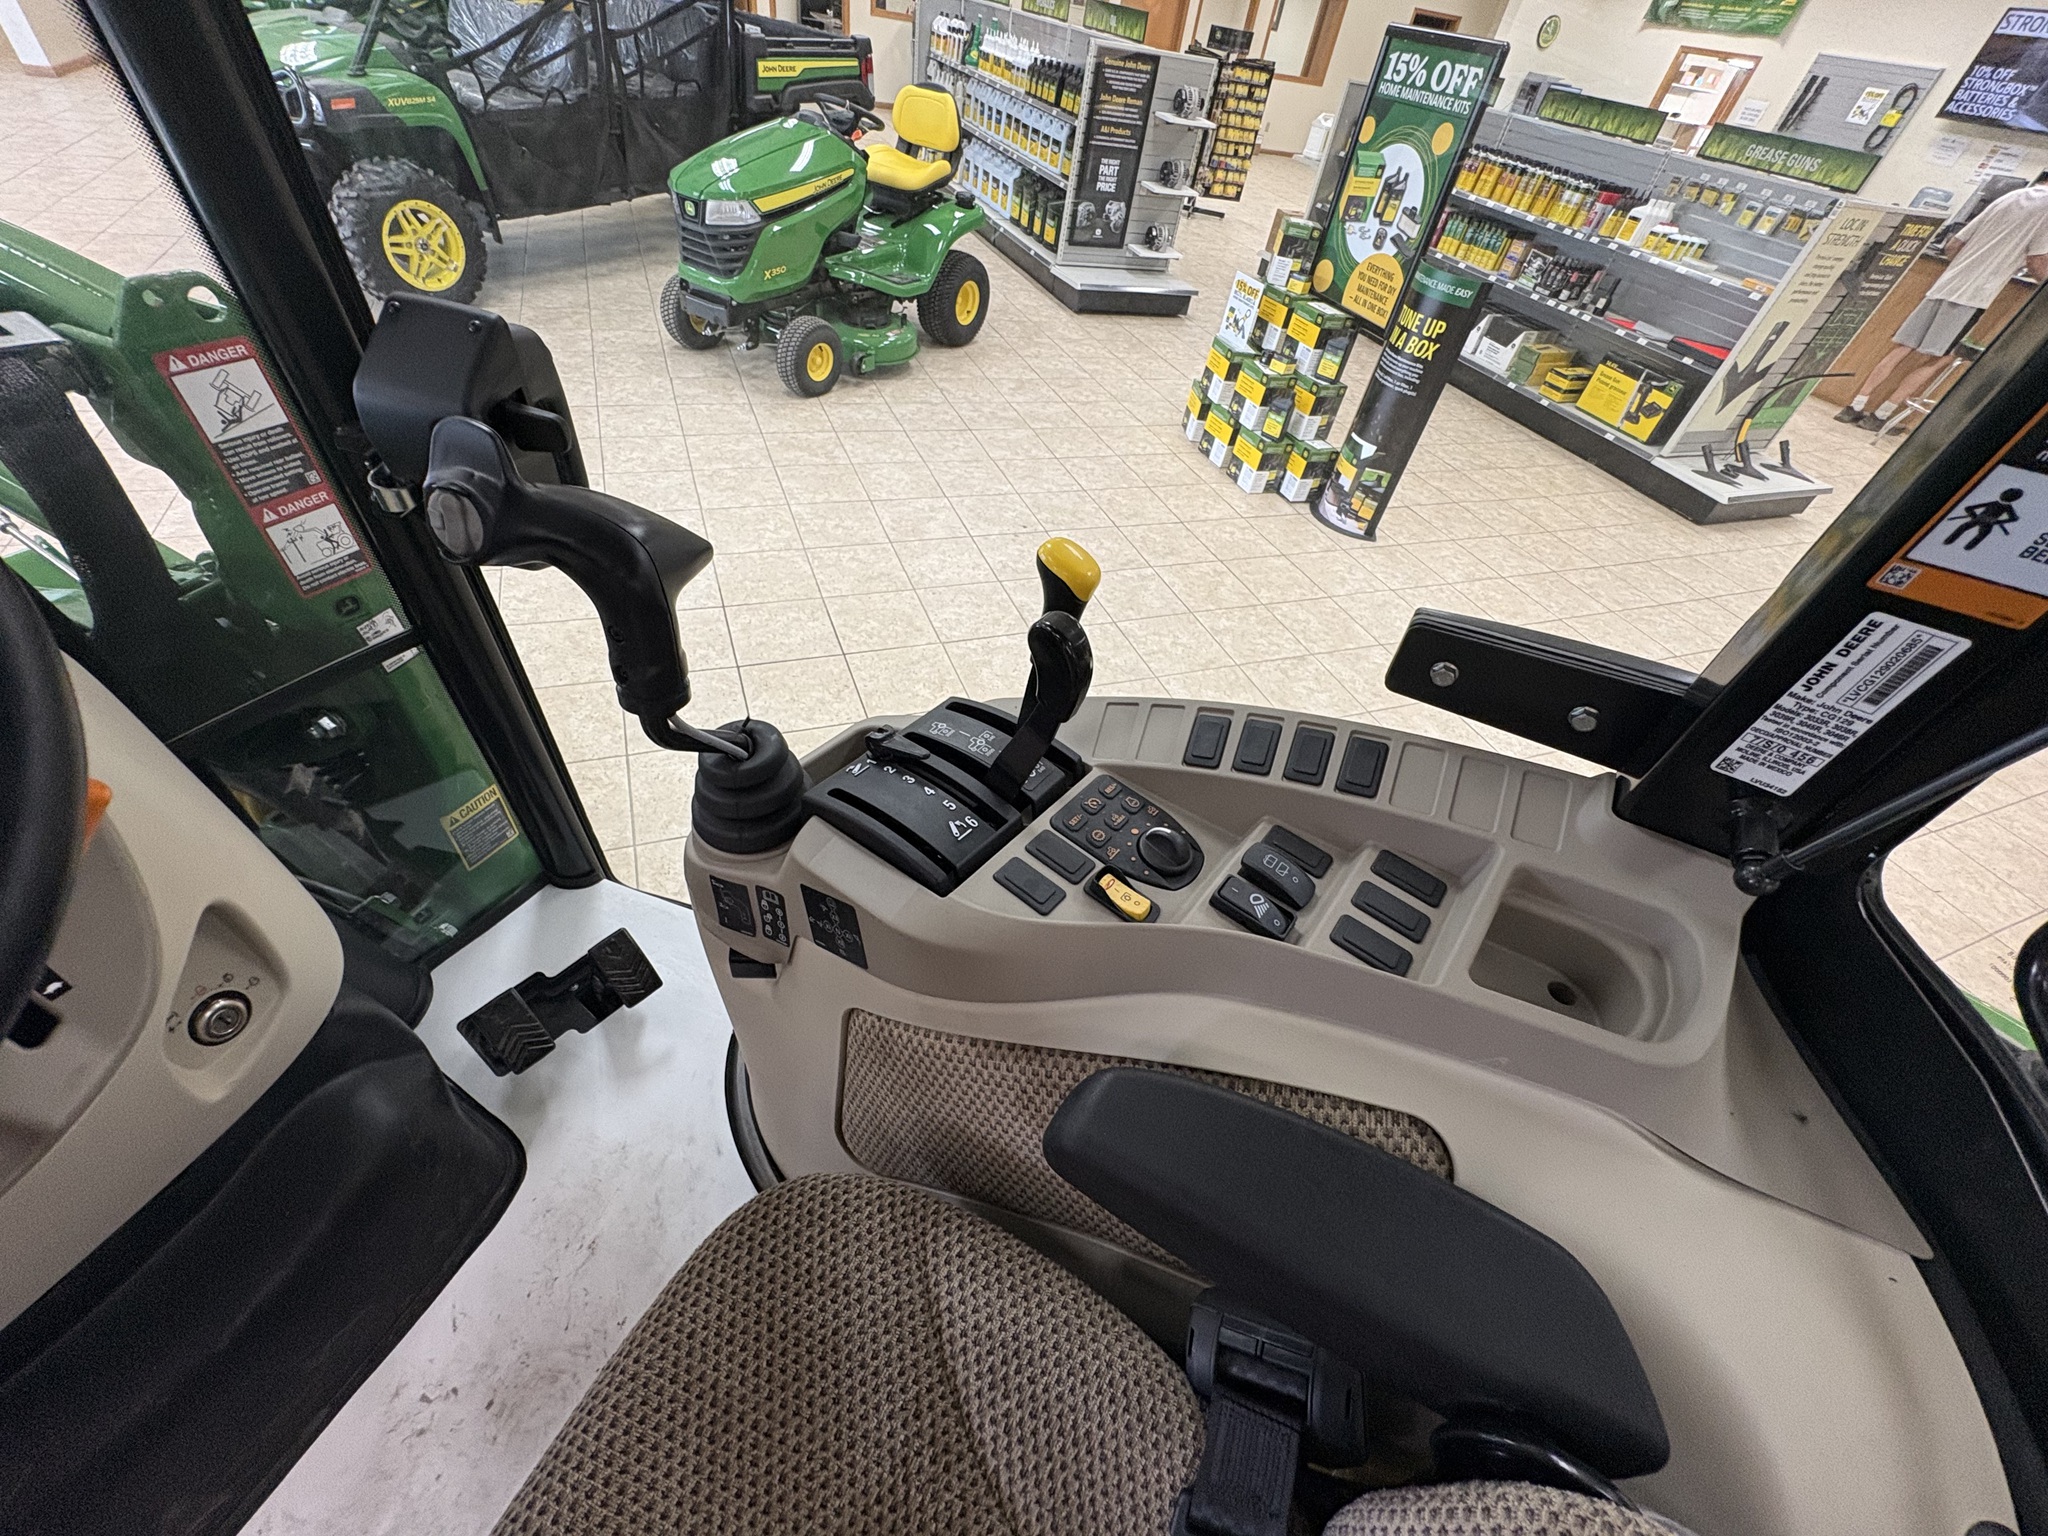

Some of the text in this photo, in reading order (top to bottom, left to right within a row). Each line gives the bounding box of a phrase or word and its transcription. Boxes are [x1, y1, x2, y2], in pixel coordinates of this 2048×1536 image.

[1384, 51, 1484, 98] 15% OFF
[1970, 65, 2019, 81] 10% OFF
[1378, 82, 1471, 115] HOME MAINTENANCE KITS
[1953, 89, 2019, 108] BATTERIES &
[1944, 102, 2017, 120] ACCESSORIES
[1744, 144, 1822, 172] GREASE GUNS
[1099, 165, 1119, 176] PART
[813, 174, 843, 194] JOHN DEERE
[1096, 182, 1116, 192] PRICE
[764, 266, 786, 280] X350
[1366, 262, 1395, 281] EVERYTHING
[1246, 285, 1260, 300] OFF
[1357, 283, 1389, 306] MAINTENANCE
[1358, 271, 1397, 296] YOU NEED FOR DIY
[1437, 282, 1456, 294] MADE
[1455, 288, 1473, 298] EASY
[1354, 296, 1362, 306] ALL
[1367, 302, 1377, 313] ONE
[1422, 317, 1447, 339] UP
[187, 344, 249, 368] DANGER
[1395, 332, 1408, 349] A
[1404, 336, 1441, 361] BOX
[278, 491, 329, 516] DANGER
[1802, 619, 1884, 692] JOHN DEERE
[1816, 624, 1900, 698] Component Serial Number
[1787, 691, 1873, 724] Make: John Deere
[1793, 701, 1855, 726] Type: CG129
[1745, 744, 1768, 754] DEERE
[1774, 754, 1807, 768] COMPANY
[1804, 746, 1833, 758] NUMBER
[1739, 754, 1758, 764] MADE
[1766, 764, 1792, 776] MEXICO
[460, 788, 497, 819] CAUTION
[884, 766, 897, 774] 2
[902, 775, 916, 784] 3
[924, 786, 936, 796] 4
[942, 800, 957, 810] 5
[965, 816, 979, 828] 6
